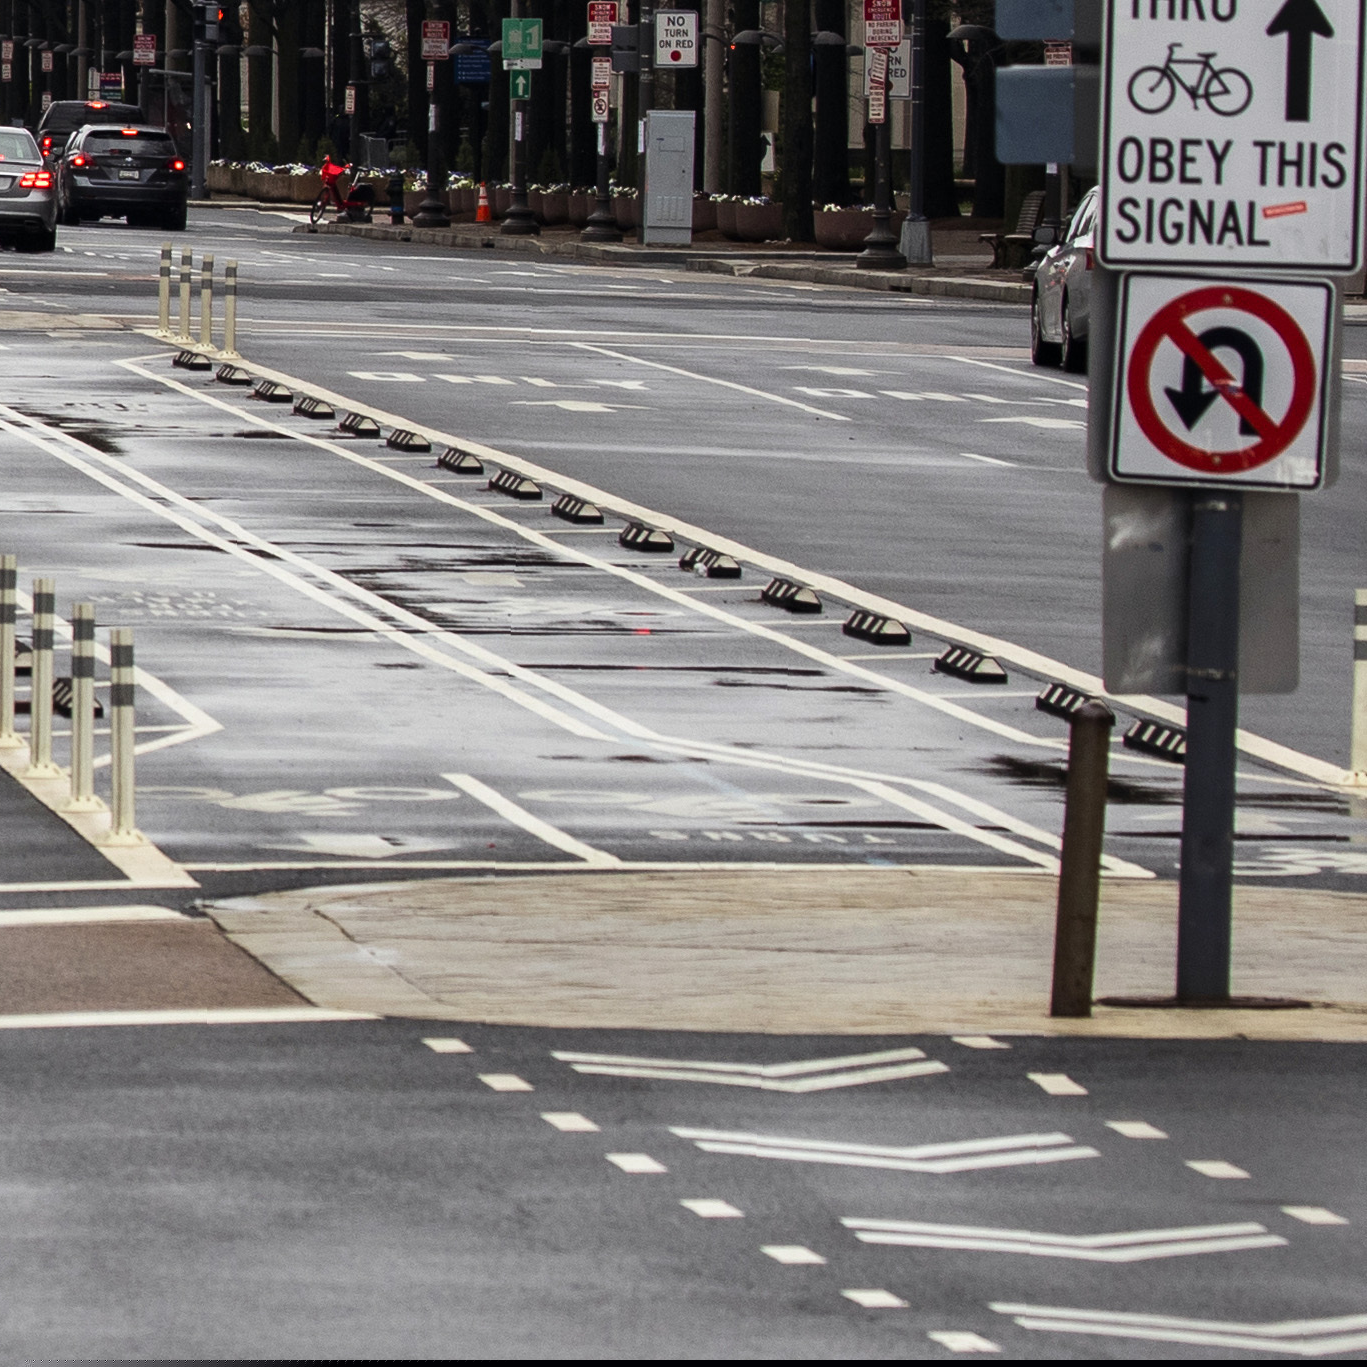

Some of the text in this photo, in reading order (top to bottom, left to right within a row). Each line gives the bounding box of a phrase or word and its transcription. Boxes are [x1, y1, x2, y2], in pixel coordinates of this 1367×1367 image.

[667, 16, 685, 27] NO
[664, 28, 689, 38] TURN
[659, 40, 694, 49] ON RED
[1117, 135, 1347, 189] OBEY THIS
[1115, 196, 1271, 247] SIGNAL
[346, 371, 651, 391] ONLY
